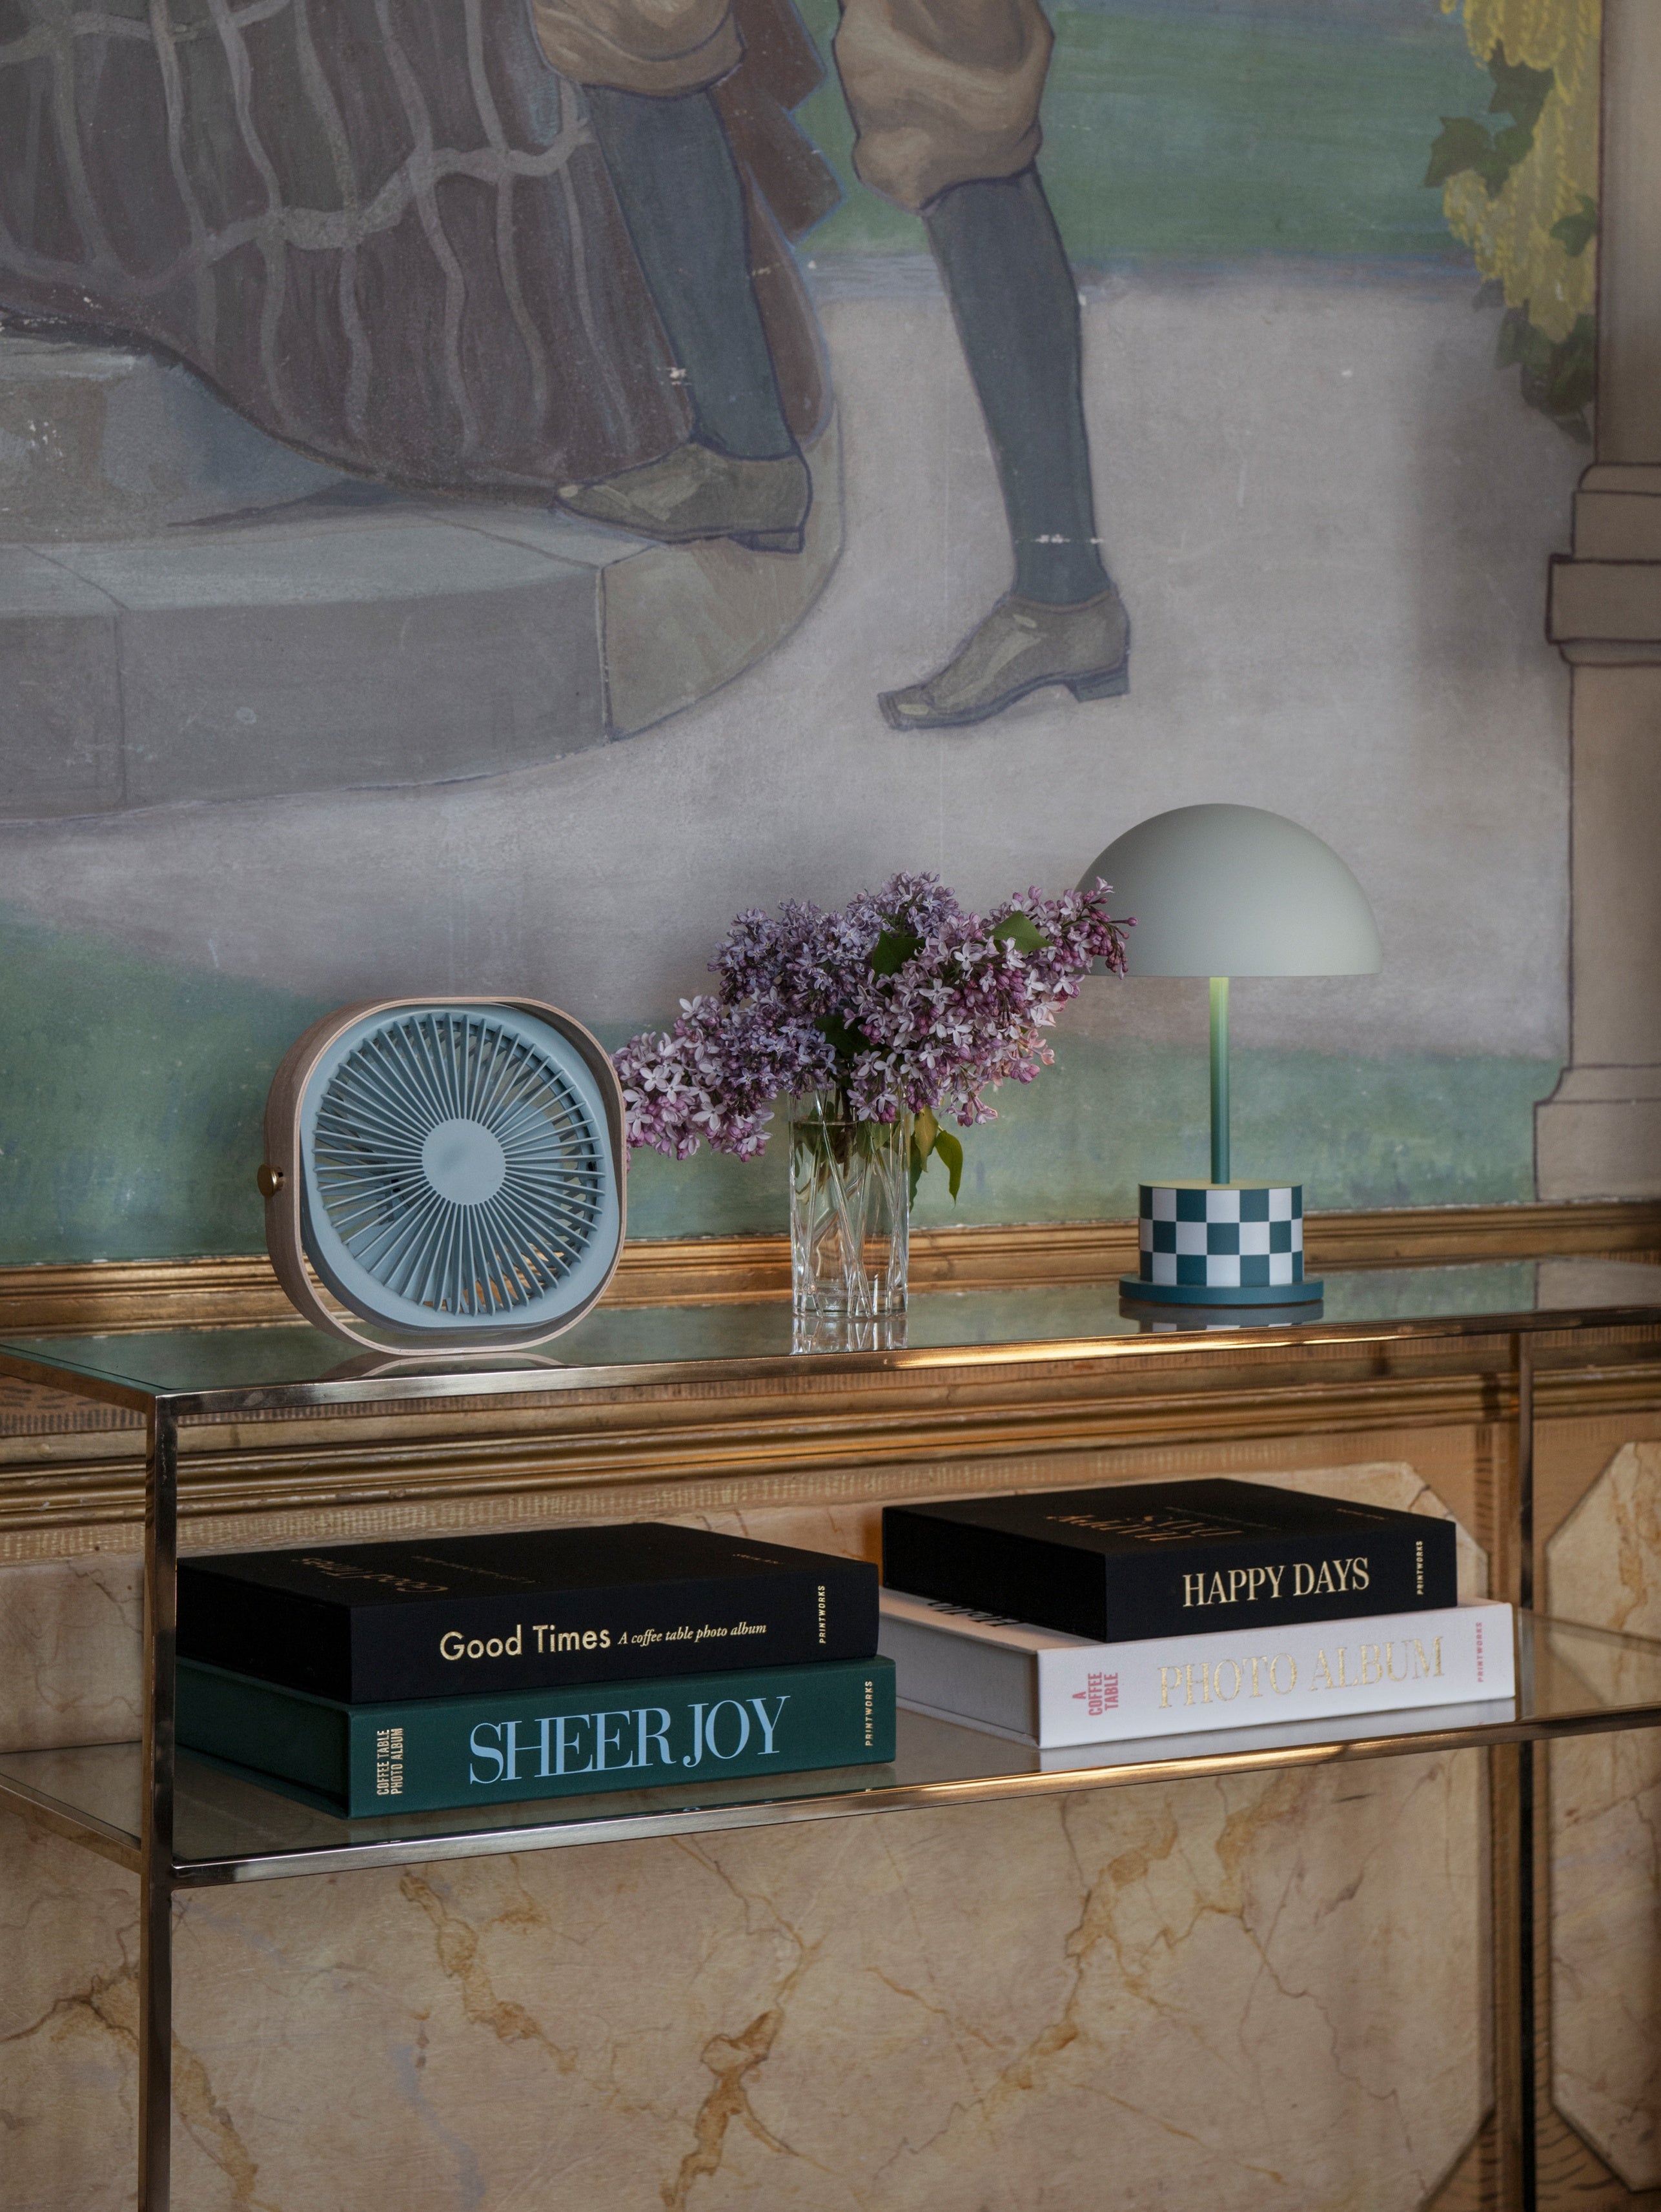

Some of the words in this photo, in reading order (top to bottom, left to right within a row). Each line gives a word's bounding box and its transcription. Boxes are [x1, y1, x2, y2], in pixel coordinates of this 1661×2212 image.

[1182, 1565, 1285, 1607] HAPPY
[1292, 1557, 1369, 1596] DAYS
[1415, 1541, 1424, 1595] PRINTWORKS
[817, 1585, 826, 1644] PRINTWORKS
[440, 1624, 522, 1661] Good
[532, 1624, 611, 1654] Times
[617, 1631, 628, 1645] A
[631, 1628, 663, 1647] coffee
[665, 1626, 694, 1641] table
[694, 1624, 728, 1643] photo
[730, 1621, 767, 1636] album
[1476, 1621, 1484, 1683] PRINTWORKS
[1088, 1672, 1103, 1716] COFFEE
[1105, 1672, 1119, 1710] TABLE
[1159, 1653, 1298, 1709] PHOTO
[1309, 1636, 1444, 1691] ALBUM
[864, 1681, 873, 1746] PRINTWORKS
[1072, 1691, 1087, 1700] A
[376, 1729, 390, 1760] TABLE
[390, 1728, 404, 1760] ALBUM
[470, 1708, 677, 1785] SHEER
[682, 1696, 791, 1768] JOY
[376, 1761, 390, 1795] COFFEE
[390, 1763, 403, 1795] PHOTO
